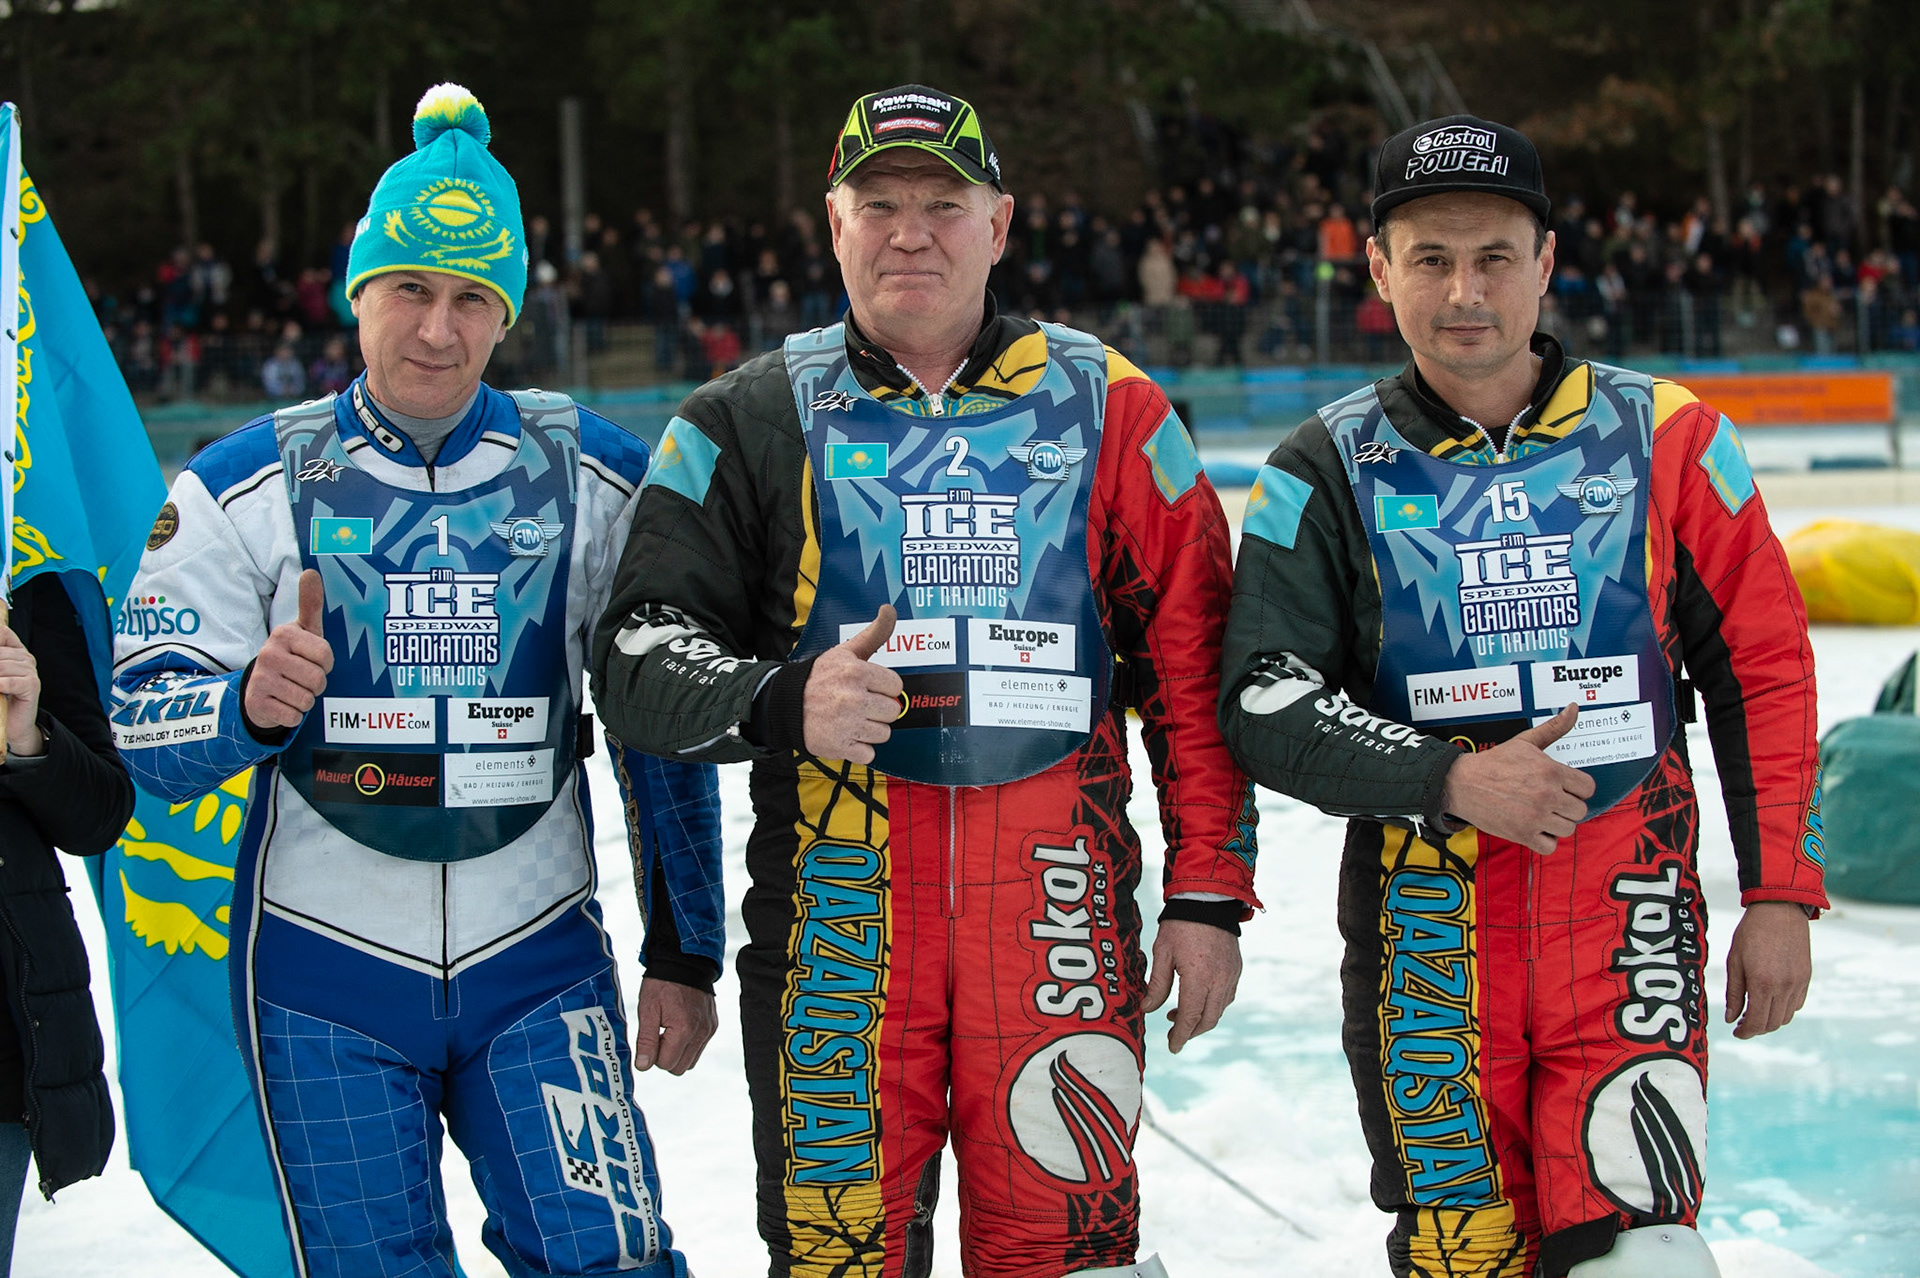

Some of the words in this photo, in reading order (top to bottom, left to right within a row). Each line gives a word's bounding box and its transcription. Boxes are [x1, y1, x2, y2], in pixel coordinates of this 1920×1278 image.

[872, 94, 951, 111] Kawasaki
[880, 103, 912, 113] Racing
[915, 103, 940, 113] Team
[1433, 130, 1491, 148] Castrol
[945, 435, 970, 477] 2
[1035, 453, 1061, 468] FIM
[949, 490, 971, 501] FIM
[1482, 481, 1530, 523] 15
[1585, 486, 1612, 502] FIM
[903, 504, 1017, 538] ICE
[430, 514, 449, 556] 1
[513, 529, 540, 545] FIM
[1502, 534, 1525, 547] FIM
[906, 543, 1014, 552] SPEEDWAY
[431, 569, 454, 581] FIM
[1457, 545, 1577, 587] ICE
[386, 583, 499, 617] ICE
[916, 587, 932, 607] OF
[1464, 583, 1573, 600] SPEEDWAY
[115, 596, 200, 642] alipso
[388, 621, 495, 631] SPEEDWAY
[989, 624, 1059, 647] Europe
[1014, 644, 1036, 652] Suisse
[1477, 634, 1495, 656] OF
[397, 665, 415, 686] OF
[1553, 664, 1623, 683] Europe
[1001, 679, 1054, 692] elements
[1579, 682, 1602, 690] Suisse
[910, 694, 961, 709] Häuser
[1053, 705, 1079, 713] ENERGIE
[468, 703, 534, 723] Europe
[173, 724, 213, 738] COMPLEX
[998, 718, 1071, 729] www.elements-show.de
[1575, 716, 1619, 730] ements
[1349, 731, 1396, 755] track
[1580, 739, 1611, 748] HEIZUNG
[1618, 734, 1643, 743] ENERGIE
[475, 760, 525, 770] elements
[316, 769, 354, 784] Mauer
[386, 773, 436, 788] Häuser
[522, 779, 544, 787] ENERGIE
[472, 795, 537, 805] www.elements-show.de
[1093, 863, 1111, 928] track
[1678, 896, 1696, 954] track
[1101, 940, 1119, 994] race
[1687, 968, 1700, 1023] race
[786, 842, 883, 1186] QAZAQSTAN
[1385, 870, 1498, 1208] QAZAQSTAN
[596, 1014, 621, 1084] COMPLEX
[615, 1089, 644, 1193] TECHNOLOGY
